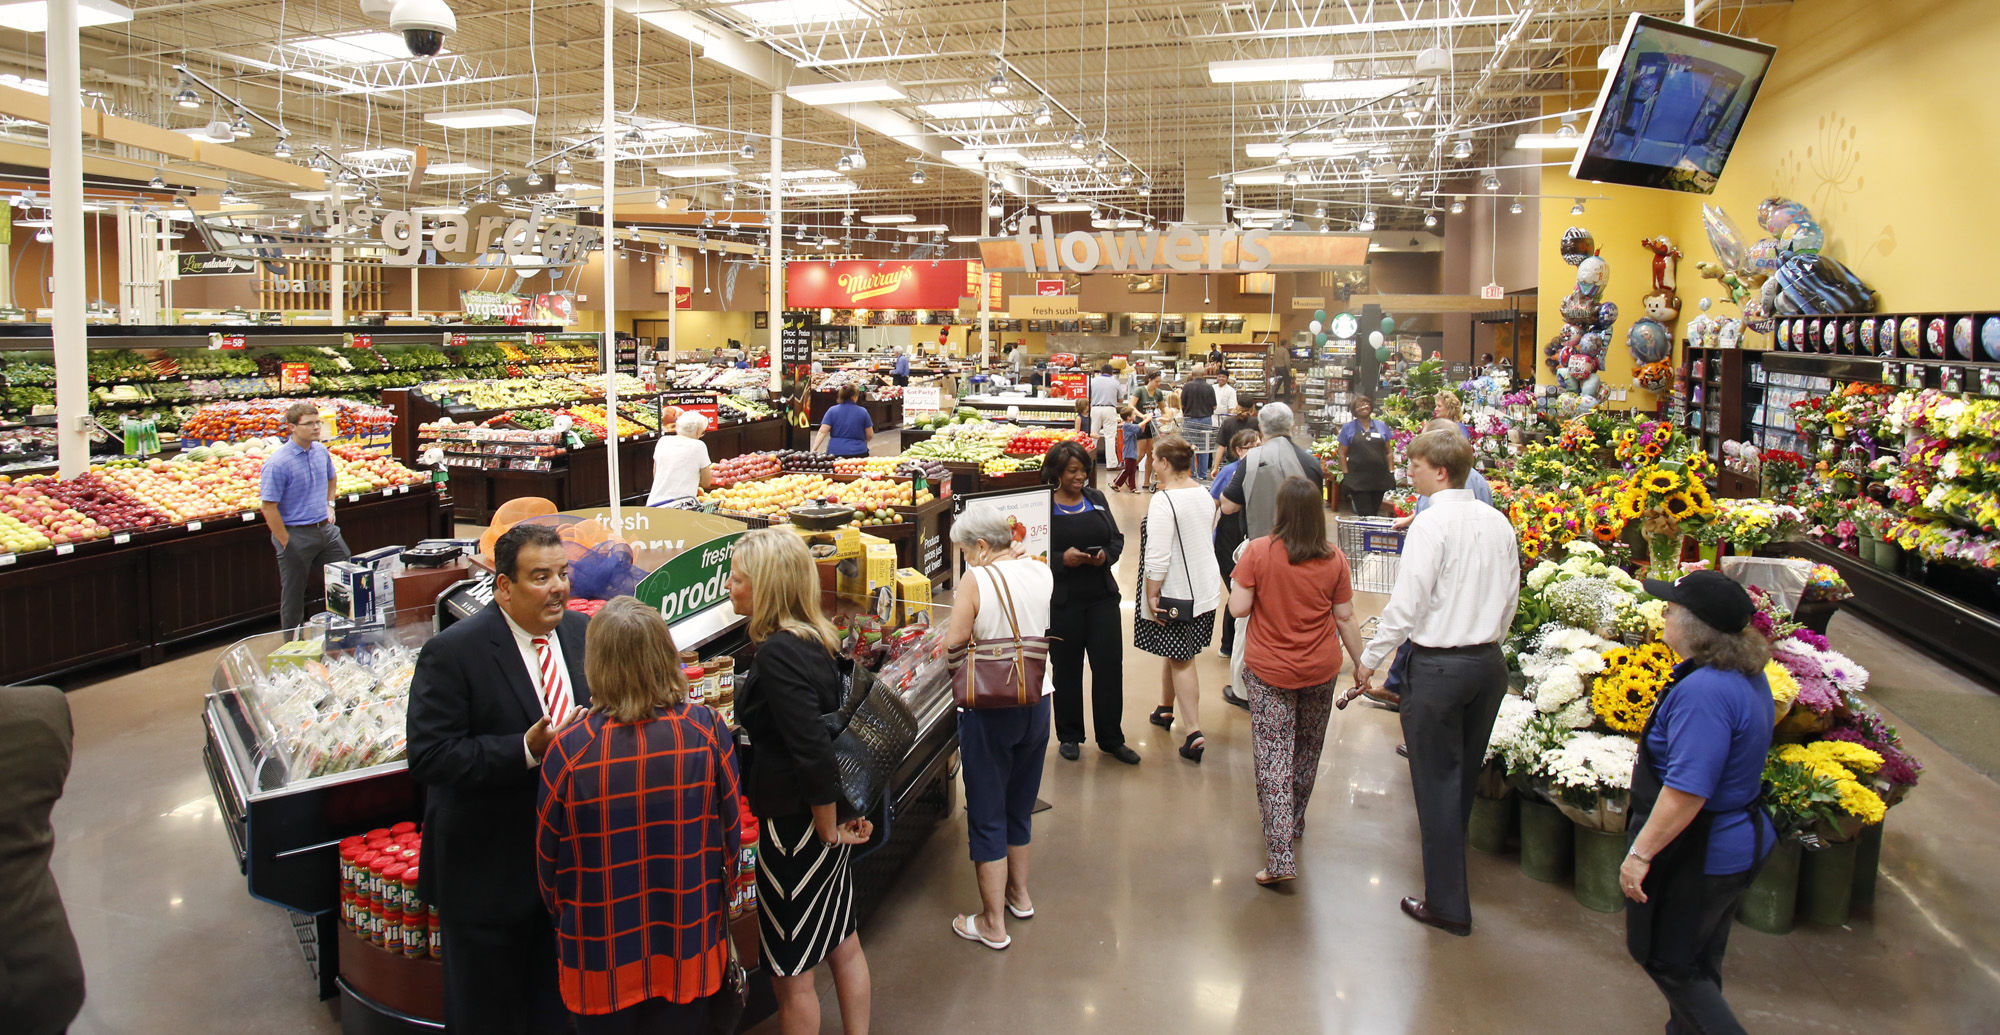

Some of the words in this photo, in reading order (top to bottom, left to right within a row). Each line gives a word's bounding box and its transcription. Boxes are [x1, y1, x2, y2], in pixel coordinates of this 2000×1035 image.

[308, 196, 375, 227] the
[380, 203, 600, 265] garden
[1016, 215, 1272, 273] flowers
[182, 255, 203, 273] Live
[202, 257, 237, 273] naturally
[273, 273, 364, 298] bakery
[838, 265, 914, 301] Murray's
[1486, 287, 1501, 298] EXIT
[470, 294, 501, 304] certified
[466, 301, 522, 320] organic
[1032, 305, 1054, 315] fresh
[1055, 306, 1078, 315] sushi
[595, 511, 650, 531] frsh
[924, 535, 940, 550] Produce
[701, 541, 734, 569] fresh
[465, 573, 495, 606] Boa
[743, 884, 756, 900] Ji
[430, 931, 441, 947] Ji
